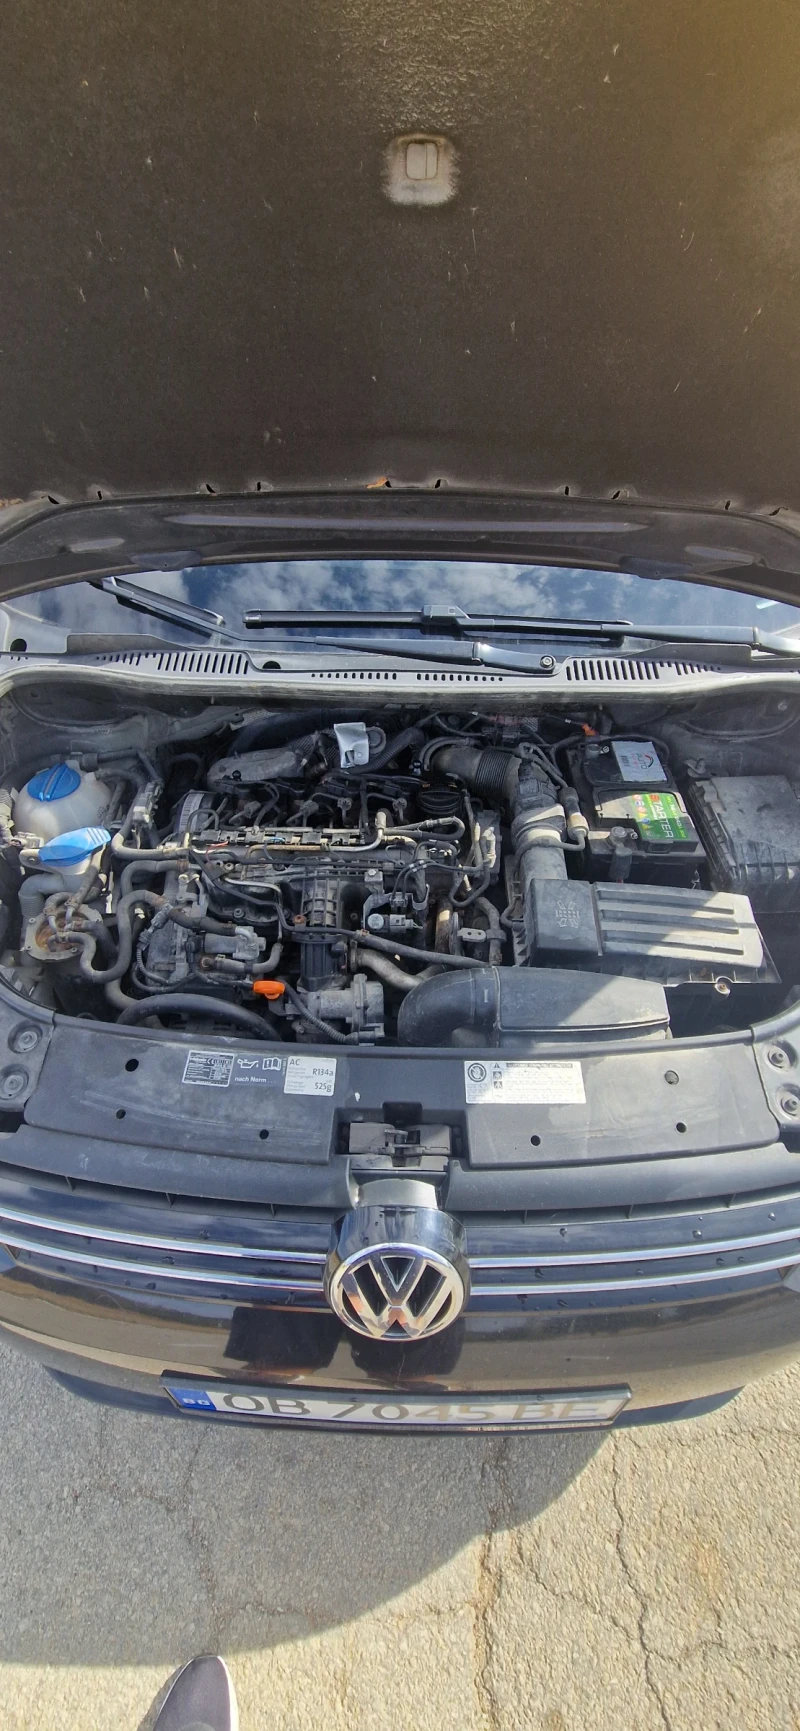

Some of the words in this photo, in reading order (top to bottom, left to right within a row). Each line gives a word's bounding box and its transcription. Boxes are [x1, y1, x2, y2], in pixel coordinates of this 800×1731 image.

[289, 1058, 300, 1066] AC
[312, 1068, 334, 1077] R134a
[314, 1082, 332, 1092] 525g
[325, 1400, 496, 1422] 7045
[511, 1400, 609, 1420] BE
